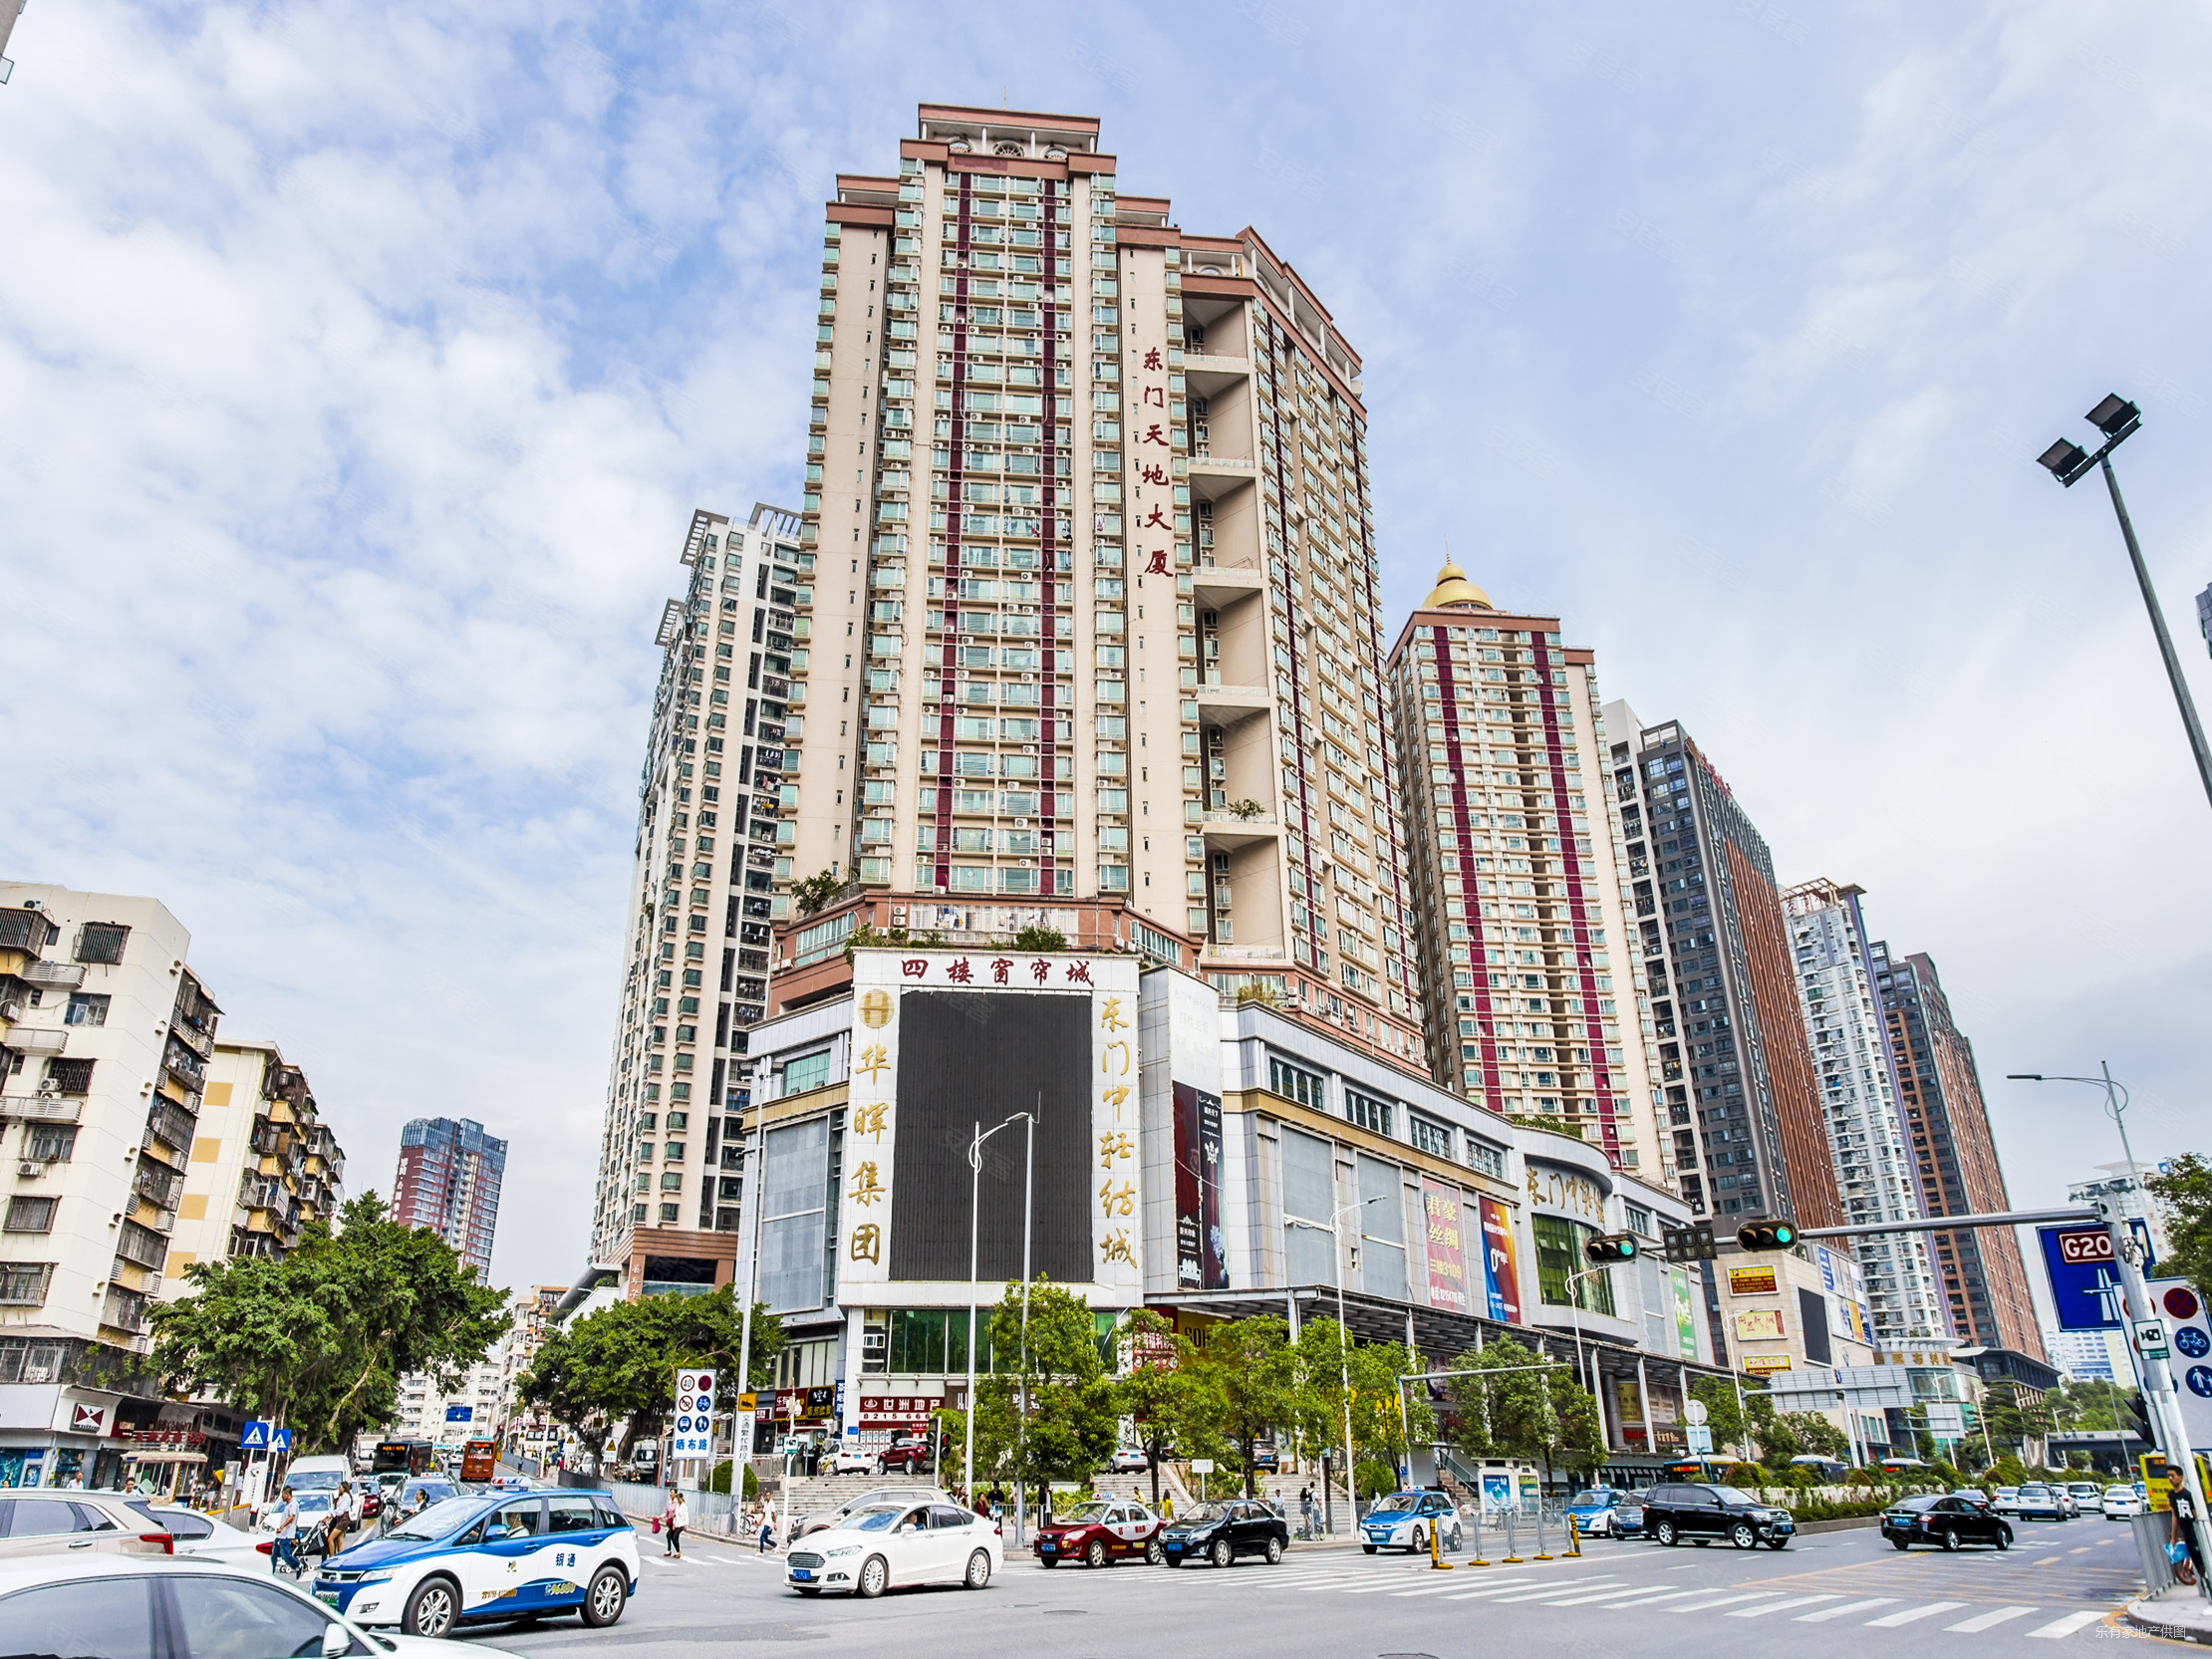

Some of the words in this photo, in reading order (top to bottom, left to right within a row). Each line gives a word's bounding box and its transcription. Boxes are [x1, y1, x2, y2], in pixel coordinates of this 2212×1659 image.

[1142, 346, 1174, 577] 东门天地大厦
[902, 958, 1094, 987] 四楼窗帘城
[1099, 994, 1139, 1269] 东门中轻纺城
[848, 1042, 892, 1266] 华晖集团
[1425, 1194, 1458, 1223] 君豪
[1428, 1223, 1461, 1251] 丝绸
[2065, 1235, 2112, 1257] G20
[684, 1378, 692, 1387] 40
[883, 1398, 941, 1411] 世洲地产
[676, 1438, 707, 1451] 晒布路
[555, 1552, 576, 1567] 银通
